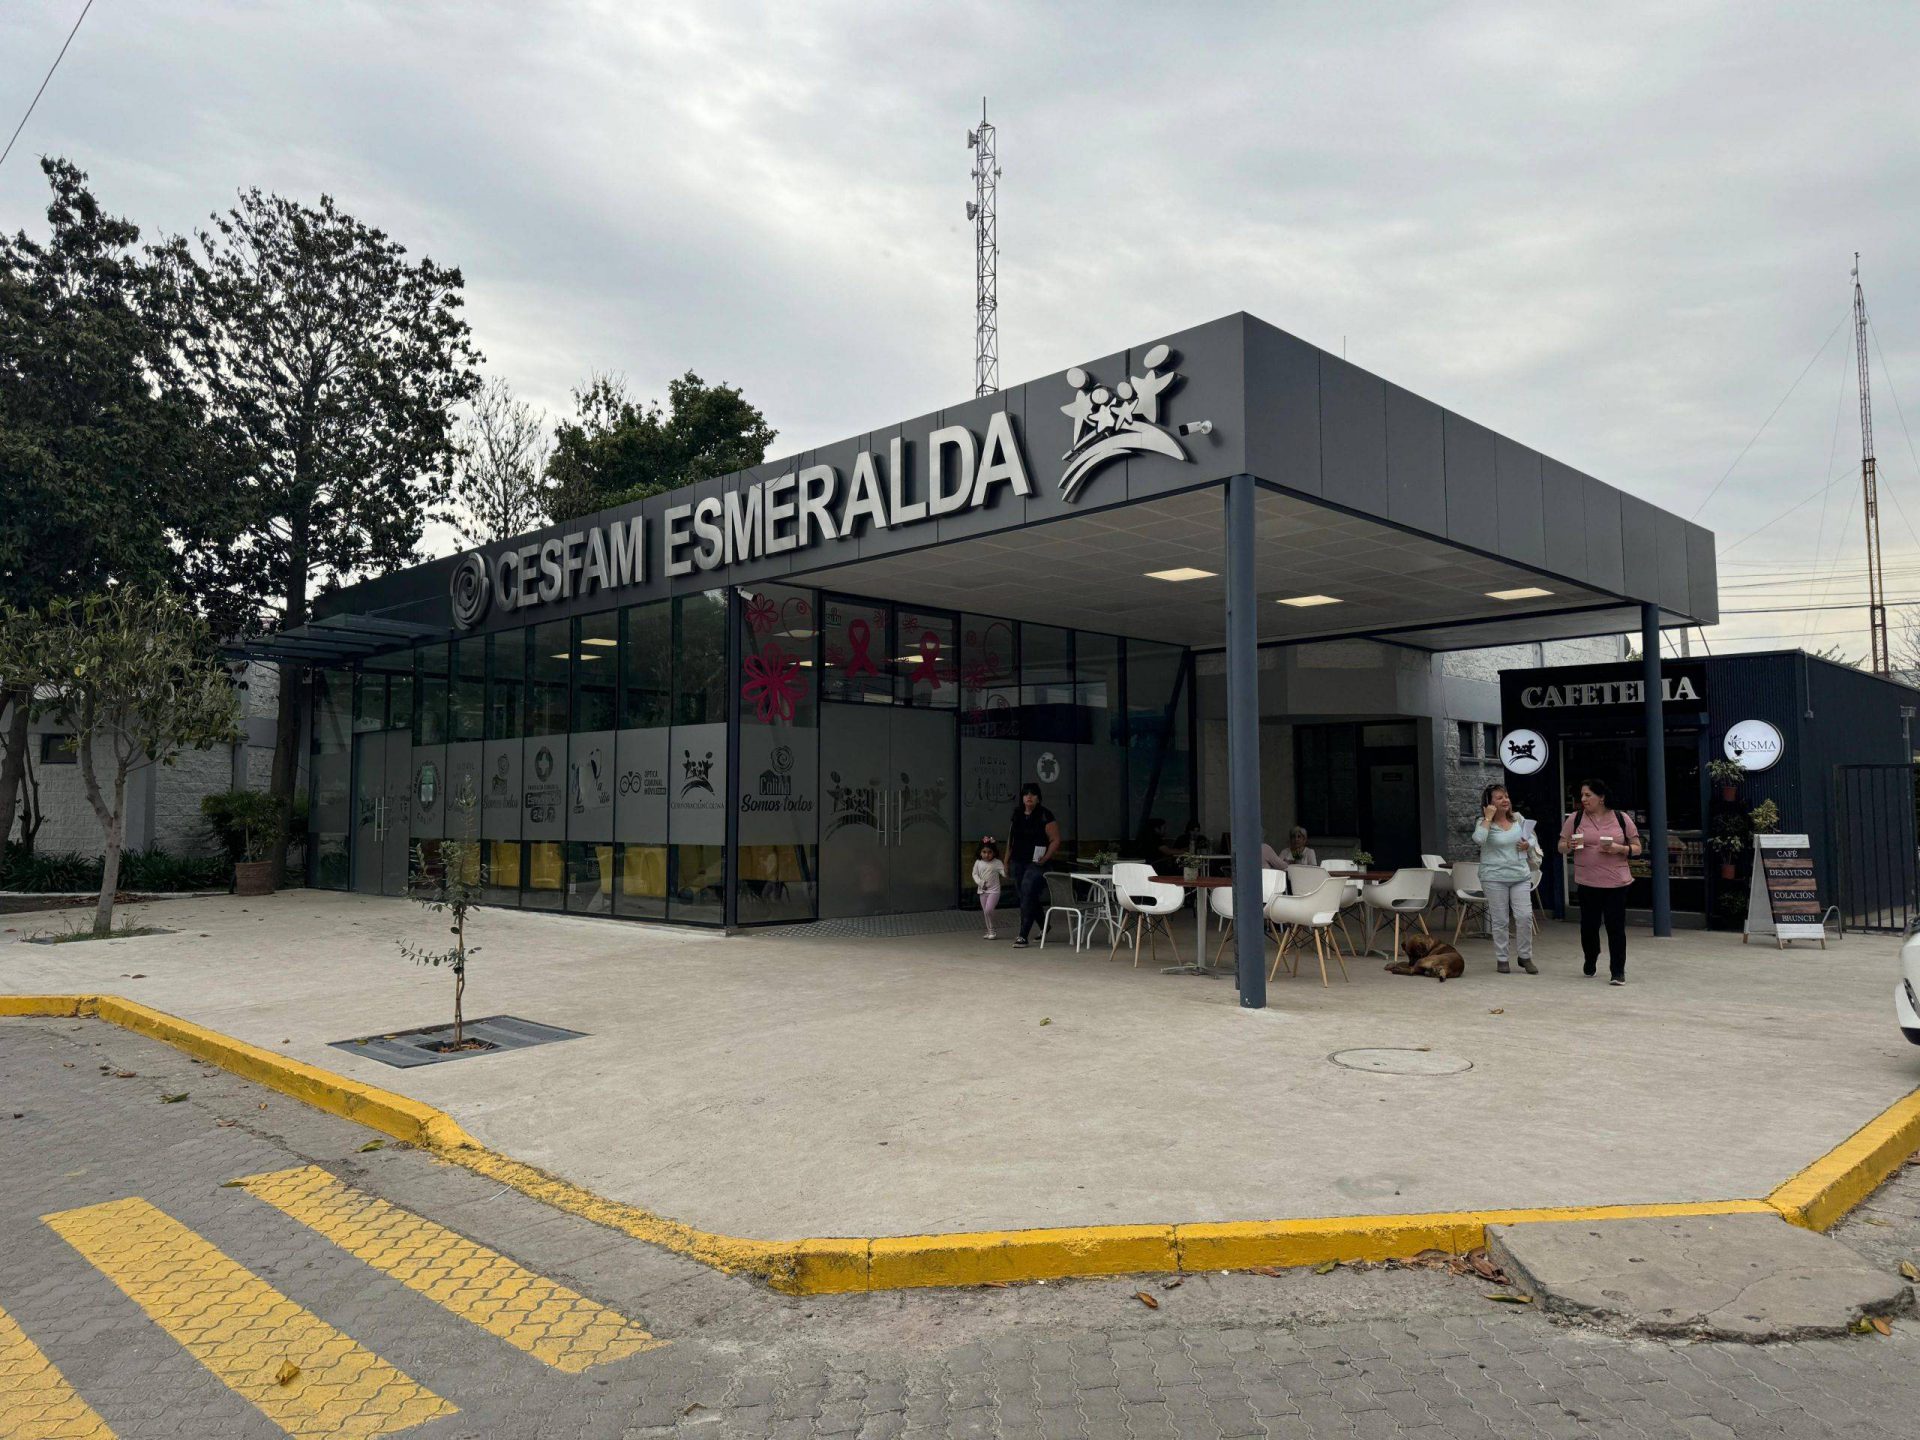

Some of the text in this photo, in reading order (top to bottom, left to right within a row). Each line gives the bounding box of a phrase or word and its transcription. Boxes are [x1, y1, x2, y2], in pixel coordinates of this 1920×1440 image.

[494, 411, 1033, 612] CESFAM ESMERALDA
[1733, 740, 1777, 750] KUSMA
[741, 793, 781, 812] Somos
[1776, 850, 1799, 858] CAFÉ
[1769, 869, 1813, 877] DESAYUNO
[1774, 891, 1816, 899] COLACIÓN
[1781, 914, 1816, 922] BRUNCH
